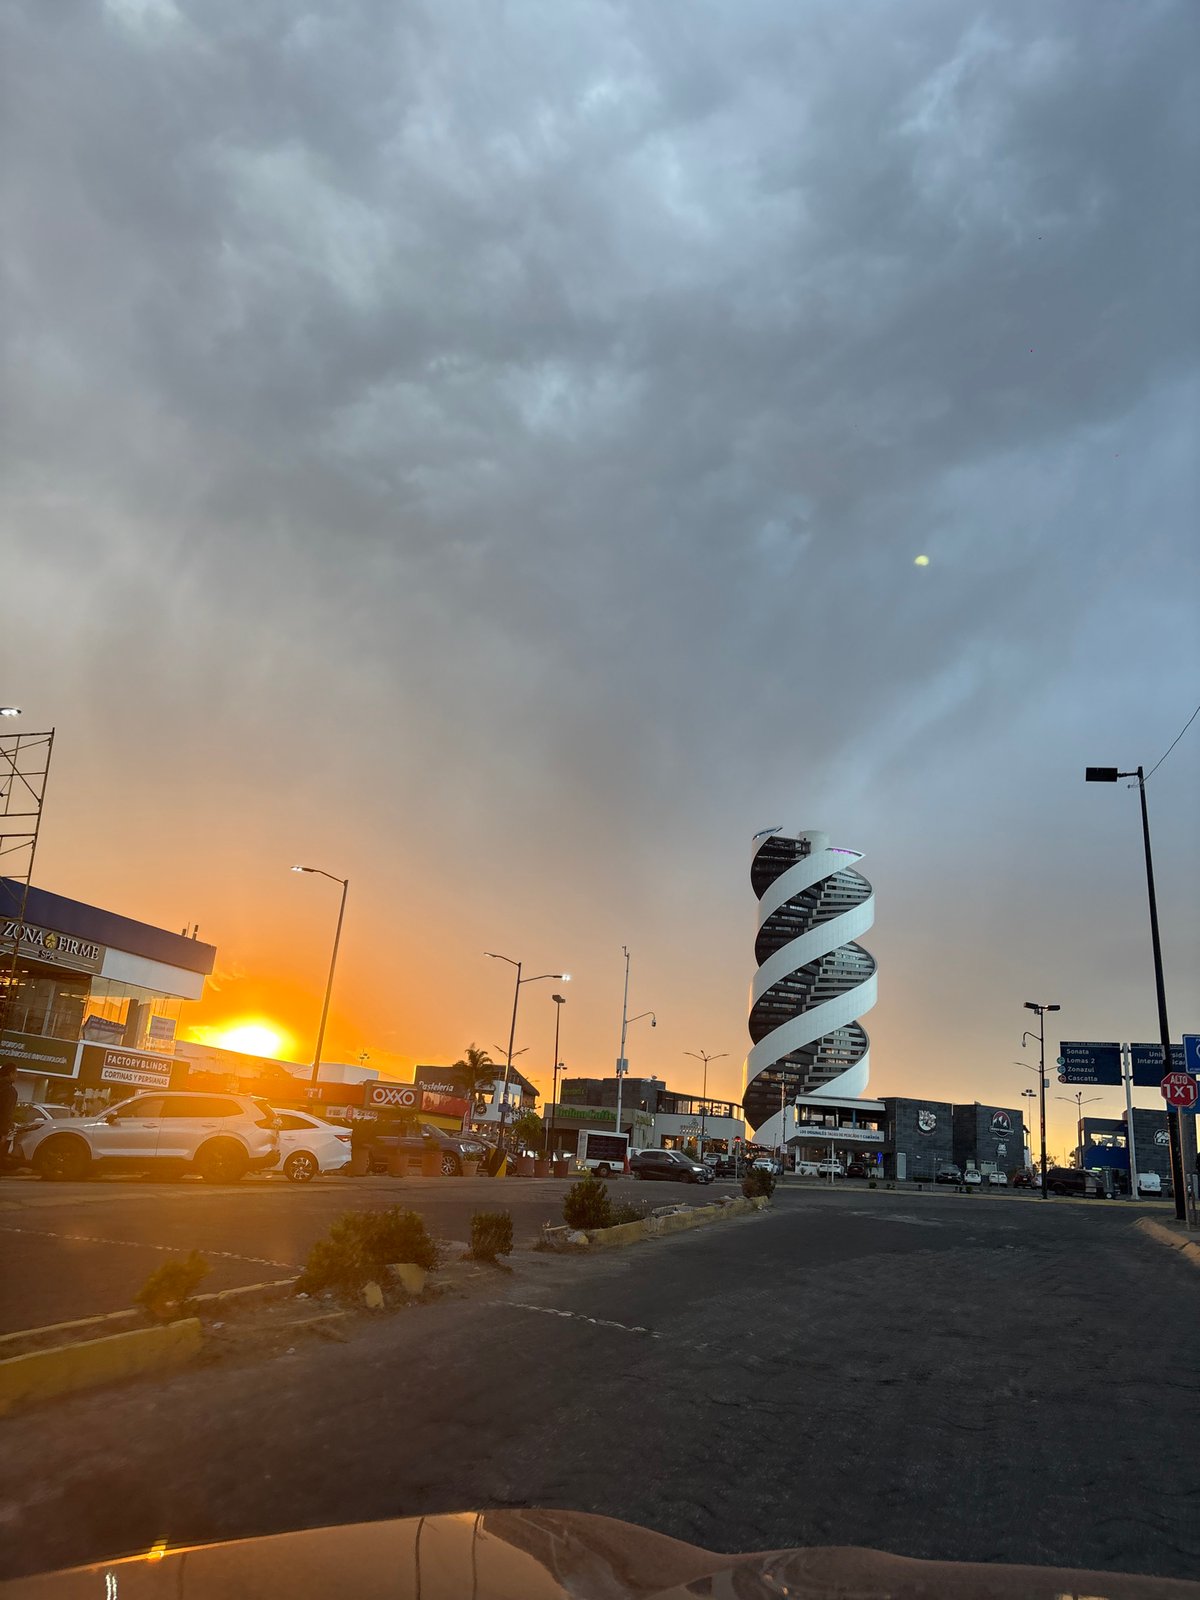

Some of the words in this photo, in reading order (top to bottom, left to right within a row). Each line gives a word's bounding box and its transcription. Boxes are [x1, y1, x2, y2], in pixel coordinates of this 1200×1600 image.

[4, 921, 43, 946] ZONA
[58, 936, 99, 960] FIRME
[41, 950, 55, 960] SPA
[107, 1055, 140, 1067] FACTORY
[104, 1070, 132, 1081] CORTINAS
[138, 1075, 167, 1086] PERSIANAS
[1067, 1074, 1098, 1082] Cascatta
[1170, 1075, 1188, 1085] ALTO
[419, 1080, 454, 1092] Pastelería
[373, 1087, 415, 1106] OXXO
